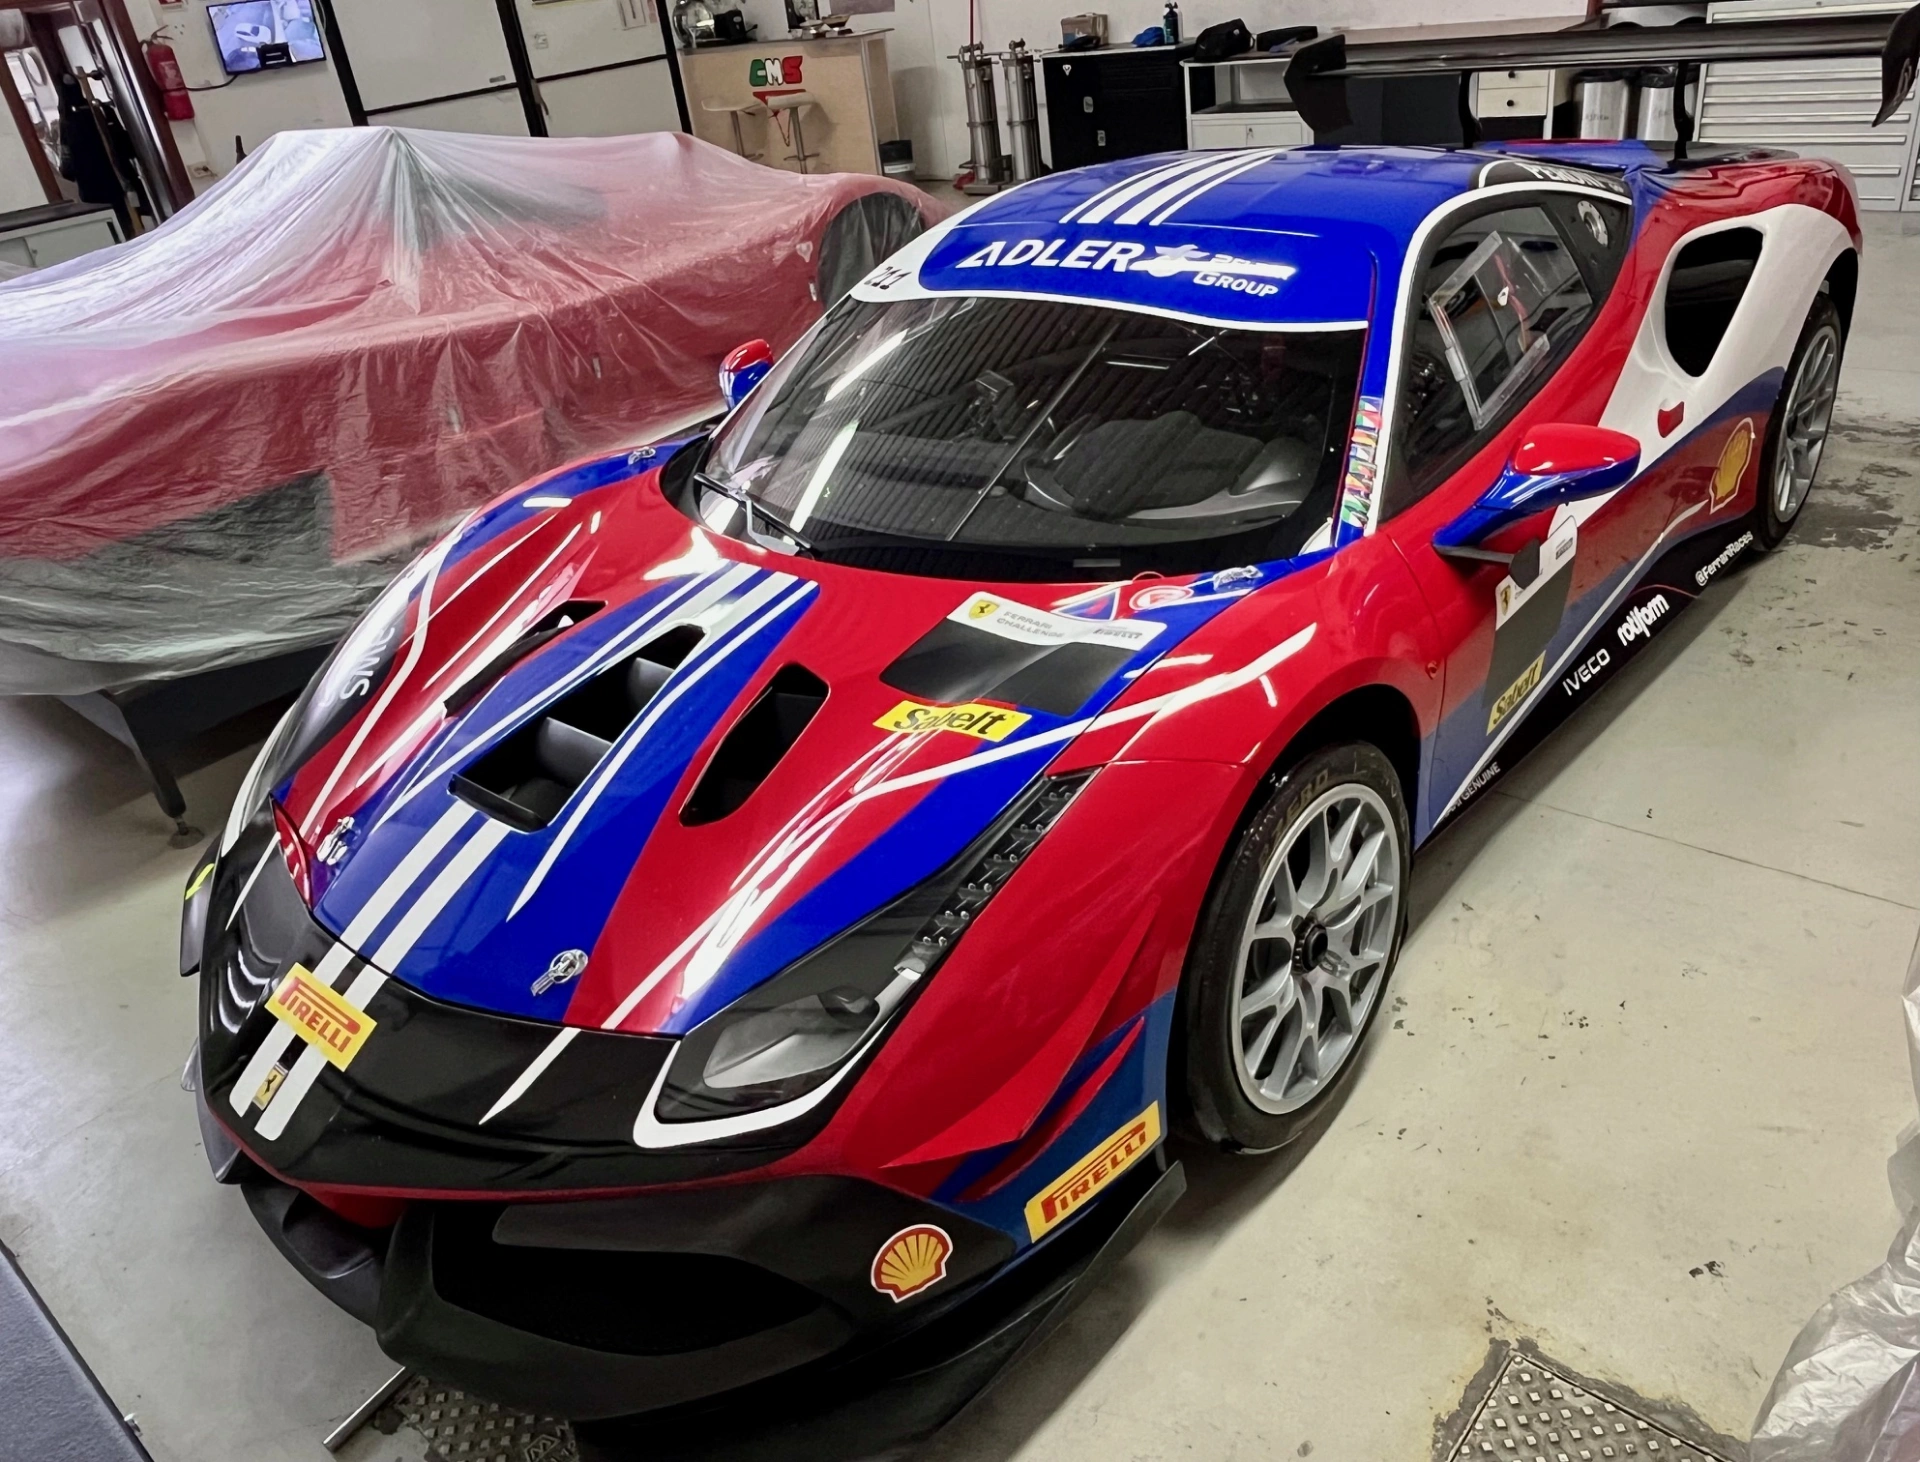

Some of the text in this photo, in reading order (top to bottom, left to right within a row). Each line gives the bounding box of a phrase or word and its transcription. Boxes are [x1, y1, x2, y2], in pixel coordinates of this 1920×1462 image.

[955, 239, 1145, 273] ADLER
[1193, 271, 1279, 296] GROUP
[996, 618, 1065, 638] CHALLENGE
[1004, 611, 1053, 629] FERRARI
[1617, 594, 1669, 646] rotiform
[1562, 648, 1611, 696] IVECO
[893, 708, 1007, 735] Sabelt
[278, 976, 361, 1053] PIRELLI
[1041, 1121, 1146, 1224] PIRELLI
